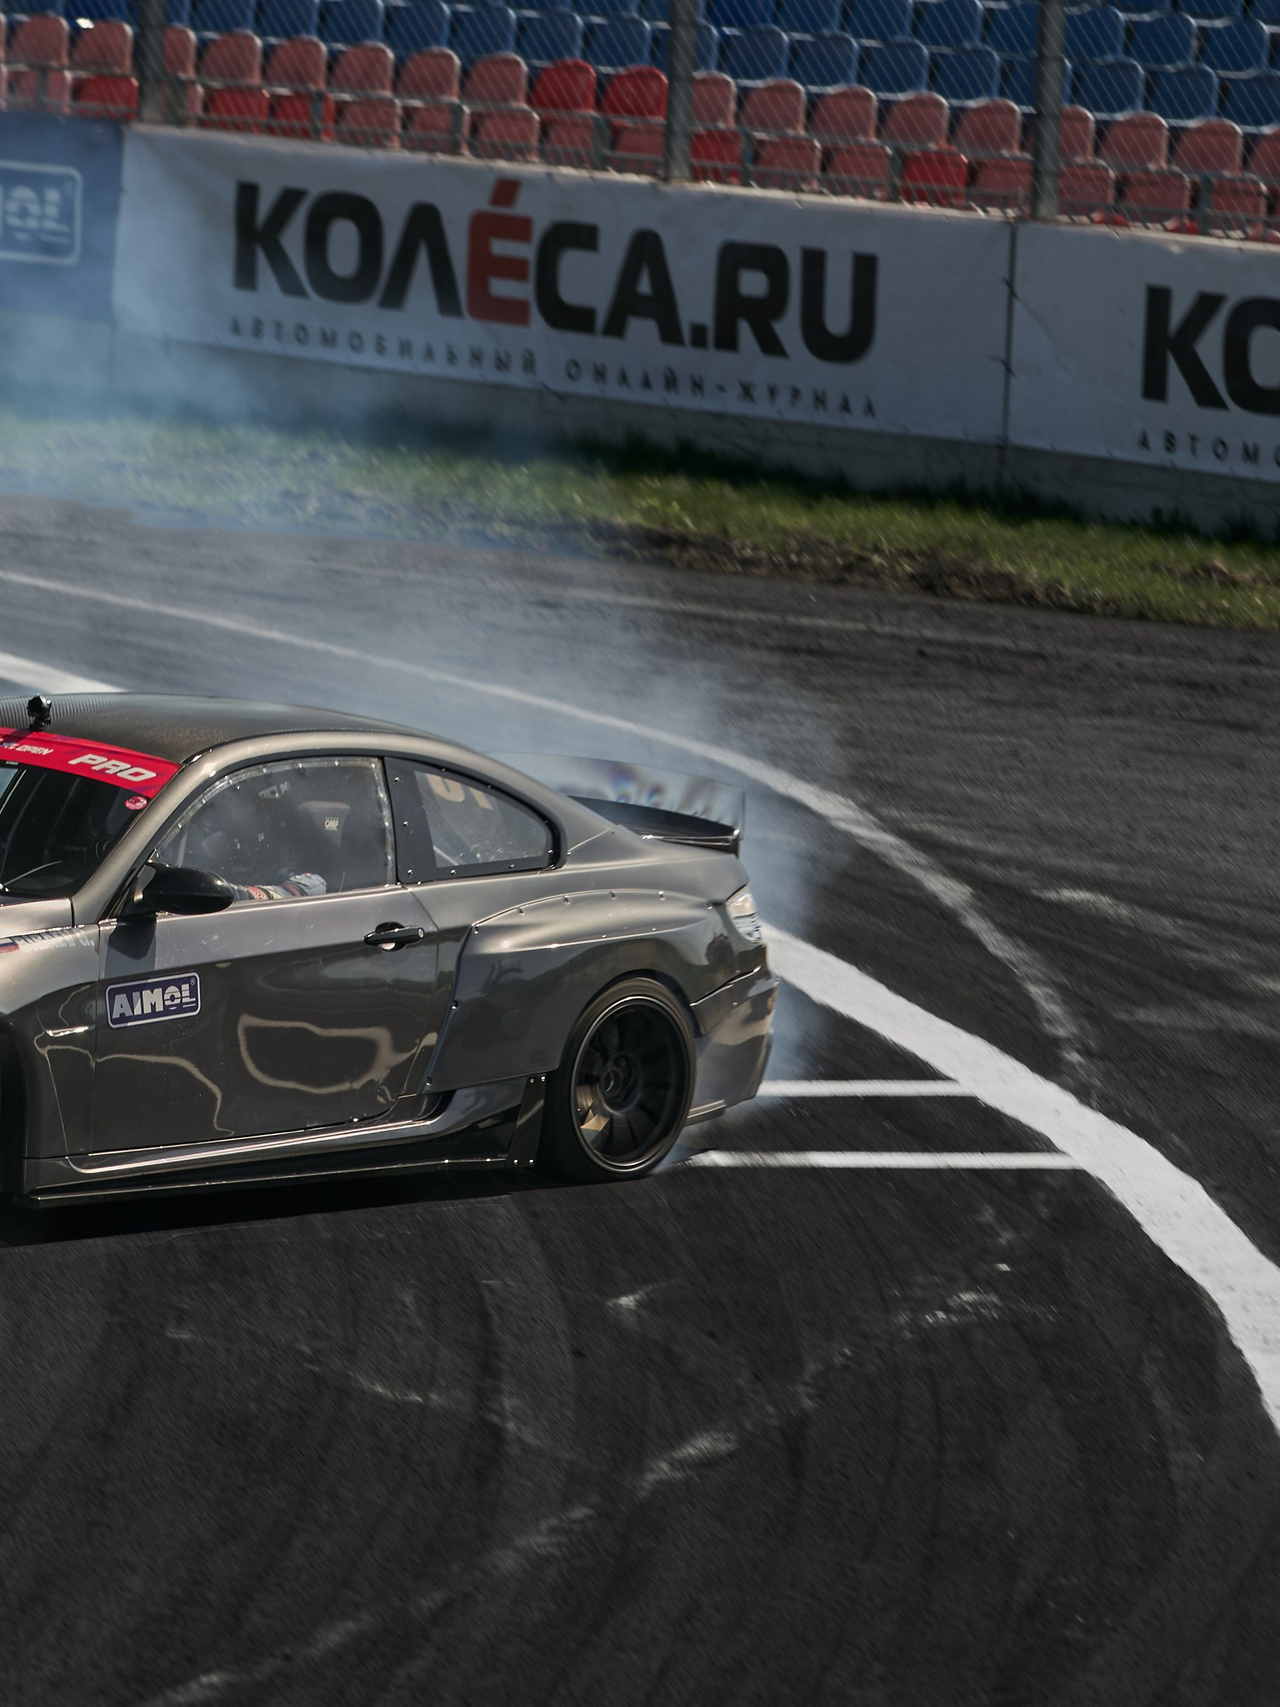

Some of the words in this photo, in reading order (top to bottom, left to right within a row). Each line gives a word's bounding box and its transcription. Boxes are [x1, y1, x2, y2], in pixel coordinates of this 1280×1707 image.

[230, 315, 538, 376] АВТОМОБИЛЬНЫЙ
[565, 357, 877, 420] ОНЛАЙН-ЖУРНАЛ
[68, 753, 157, 782] PRO
[112, 983, 197, 1019] AIMOL
